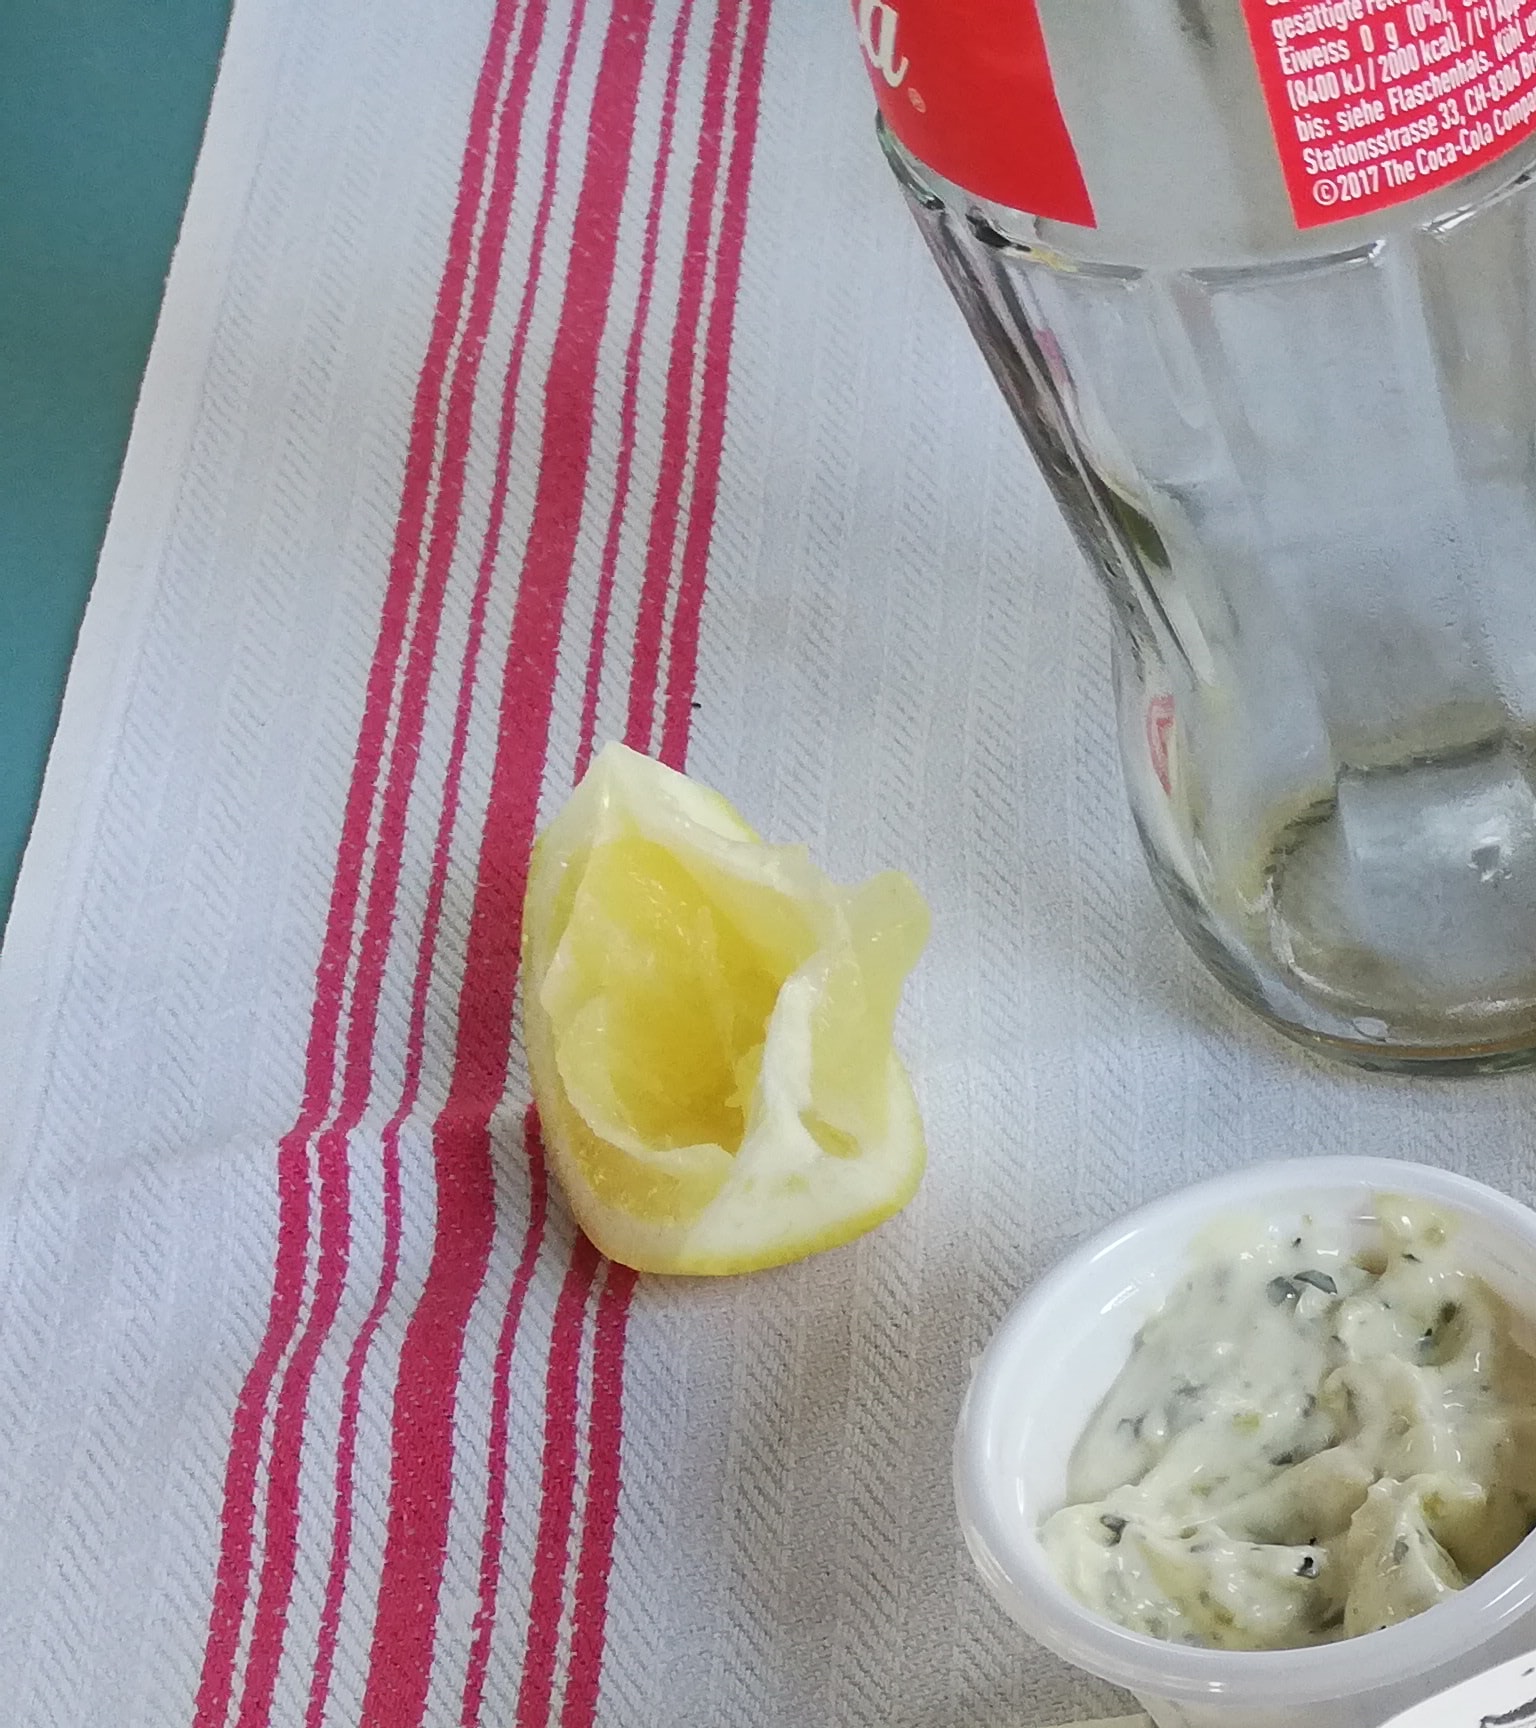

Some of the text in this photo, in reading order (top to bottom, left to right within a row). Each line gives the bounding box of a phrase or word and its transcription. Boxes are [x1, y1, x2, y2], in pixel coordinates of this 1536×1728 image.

[1277, 38, 1350, 75] Eiweiss
[1359, 24, 1375, 53] 0
[1384, 22, 1399, 50] g
[1286, 71, 1341, 111] (8400
[1339, 64, 1366, 95] kJ
[1377, 43, 1420, 83] 2000
[1419, 20, 1466, 66] kcal).
[1295, 112, 1333, 142] bis:
[1335, 97, 1386, 132] siehe
[1387, 50, 1494, 116] Flaschenhals.
[1303, 111, 1440, 175] Stationsstrasse
[1441, 98, 1466, 127] 33,
[1464, 60, 1521, 116] CH-8306
[1381, 160, 1417, 187] The
[1418, 117, 1495, 172] Coca-Cola
